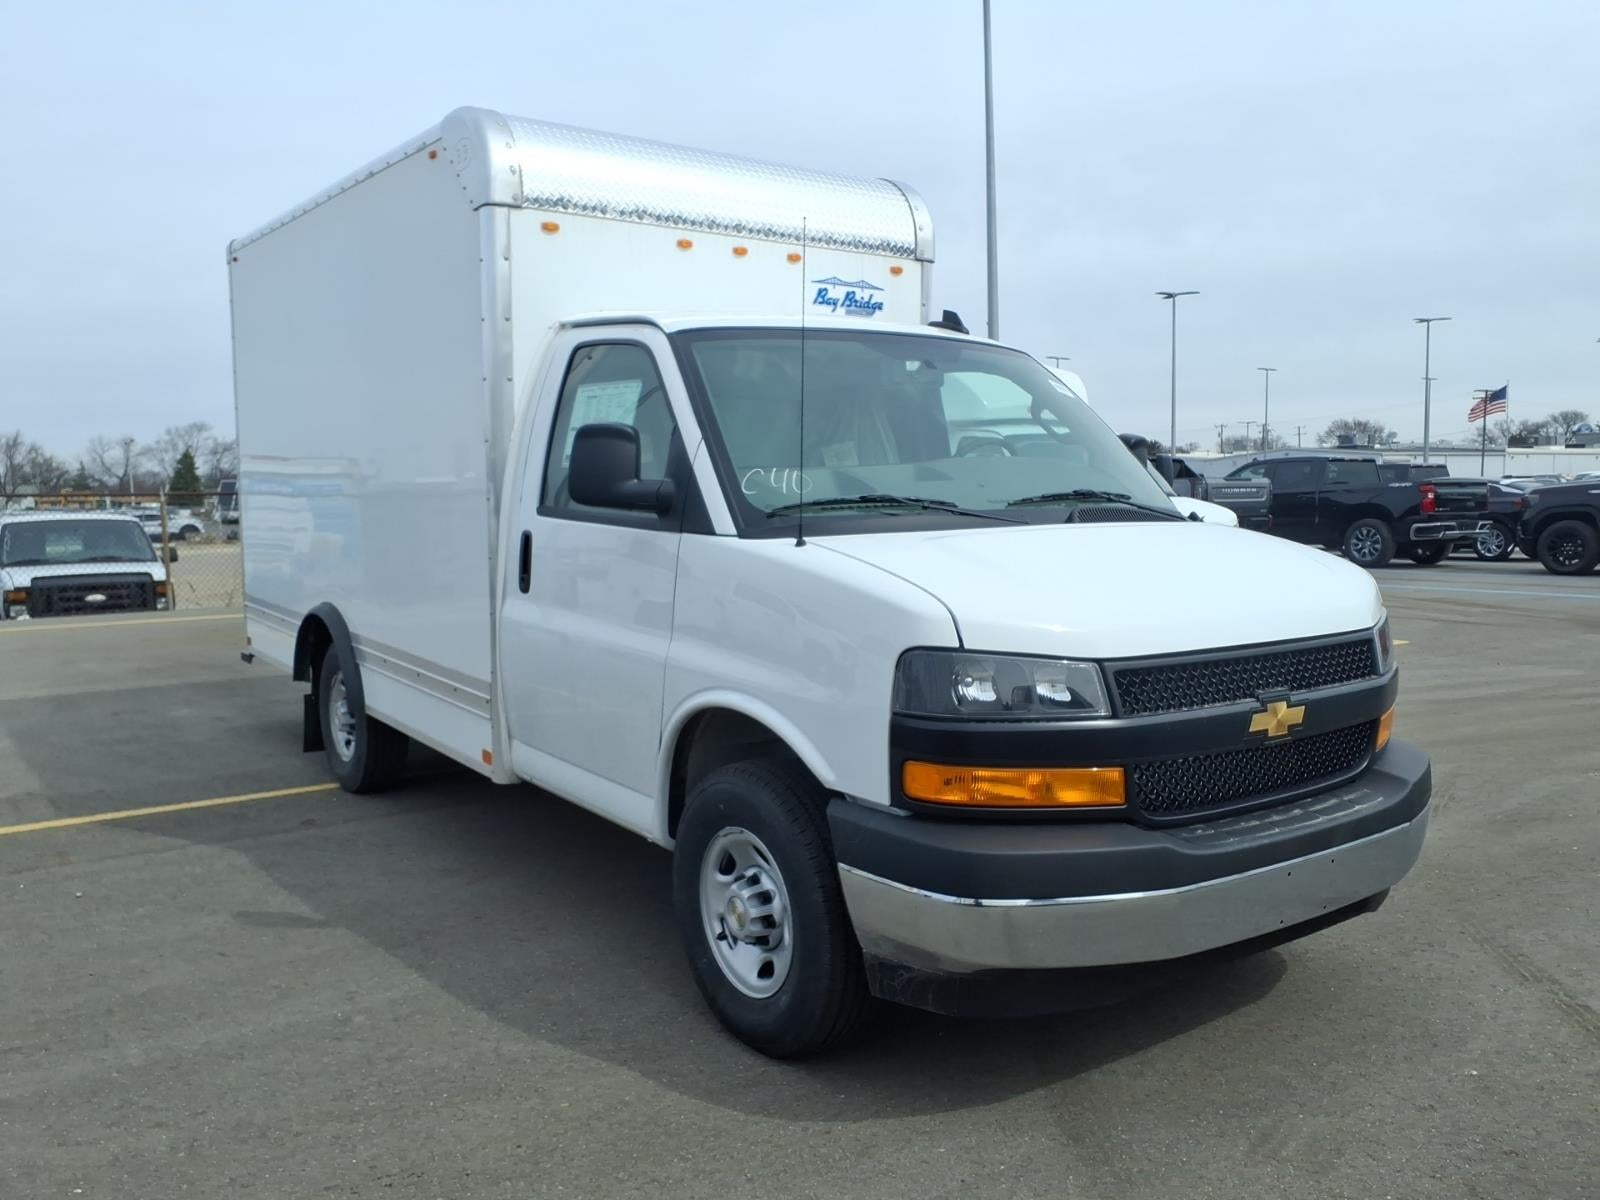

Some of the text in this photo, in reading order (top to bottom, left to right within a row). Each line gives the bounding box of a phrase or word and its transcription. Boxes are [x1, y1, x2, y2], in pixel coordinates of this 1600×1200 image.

[812, 287, 884, 313] Bay Bridge
[741, 467, 813, 495] C40
